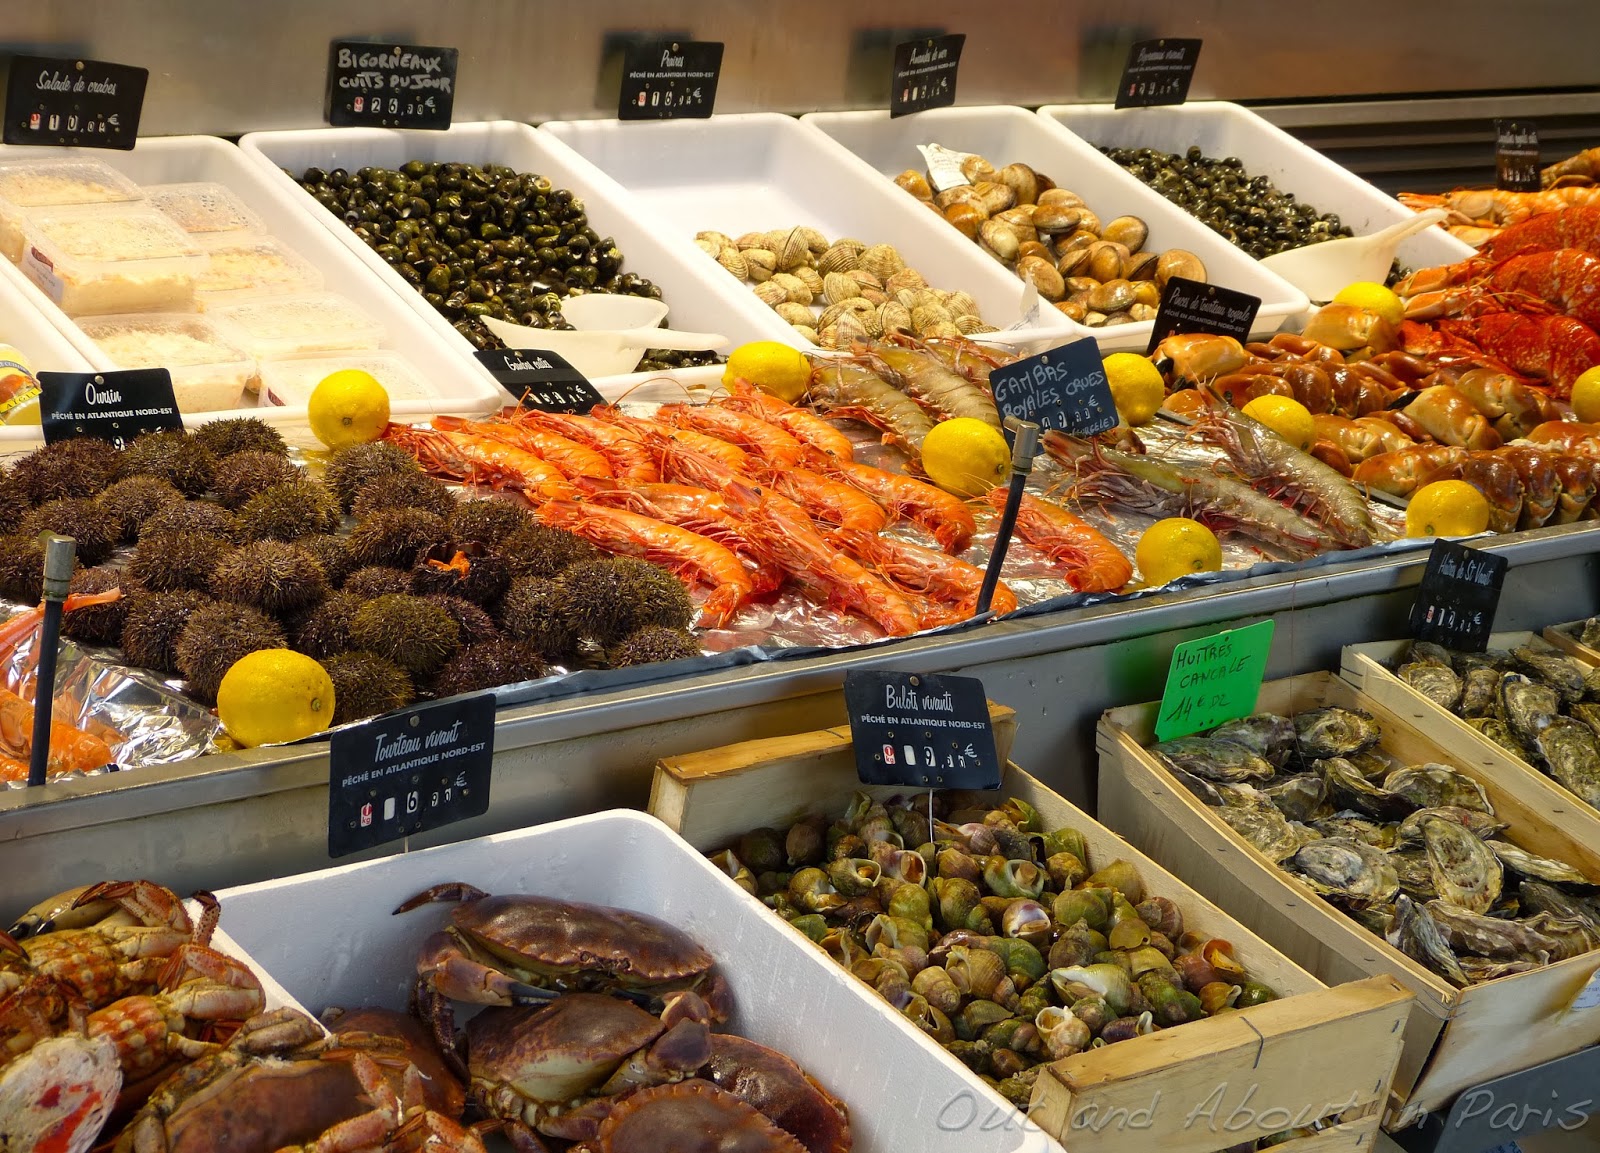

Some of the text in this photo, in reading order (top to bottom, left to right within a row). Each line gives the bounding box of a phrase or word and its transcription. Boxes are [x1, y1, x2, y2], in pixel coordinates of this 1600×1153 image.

[338, 48, 441, 73] BIGORNEAUX
[36, 70, 117, 96] Salade de crabes
[339, 71, 384, 89] CUITS
[647, 71, 655, 79] EN
[1189, 295, 1200, 310] de
[1188, 315, 1217, 327] ATLANTIQUE
[995, 361, 1068, 402] GAMBAS
[85, 382, 122, 406] Oursin
[51, 407, 173, 420] PÊCHÉ EN ATLANTIQUE NORD-EST
[1180, 655, 1252, 689] CANCALE
[886, 684, 954, 713] Bulots vivants
[861, 713, 986, 730] PÊCHÉ EN ATLANTIQUE NORD-EST
[374, 719, 463, 763] Tourteau vivant
[342, 742, 486, 788] PÊCHÉ EN ATLANTIQUE NORD-EST
